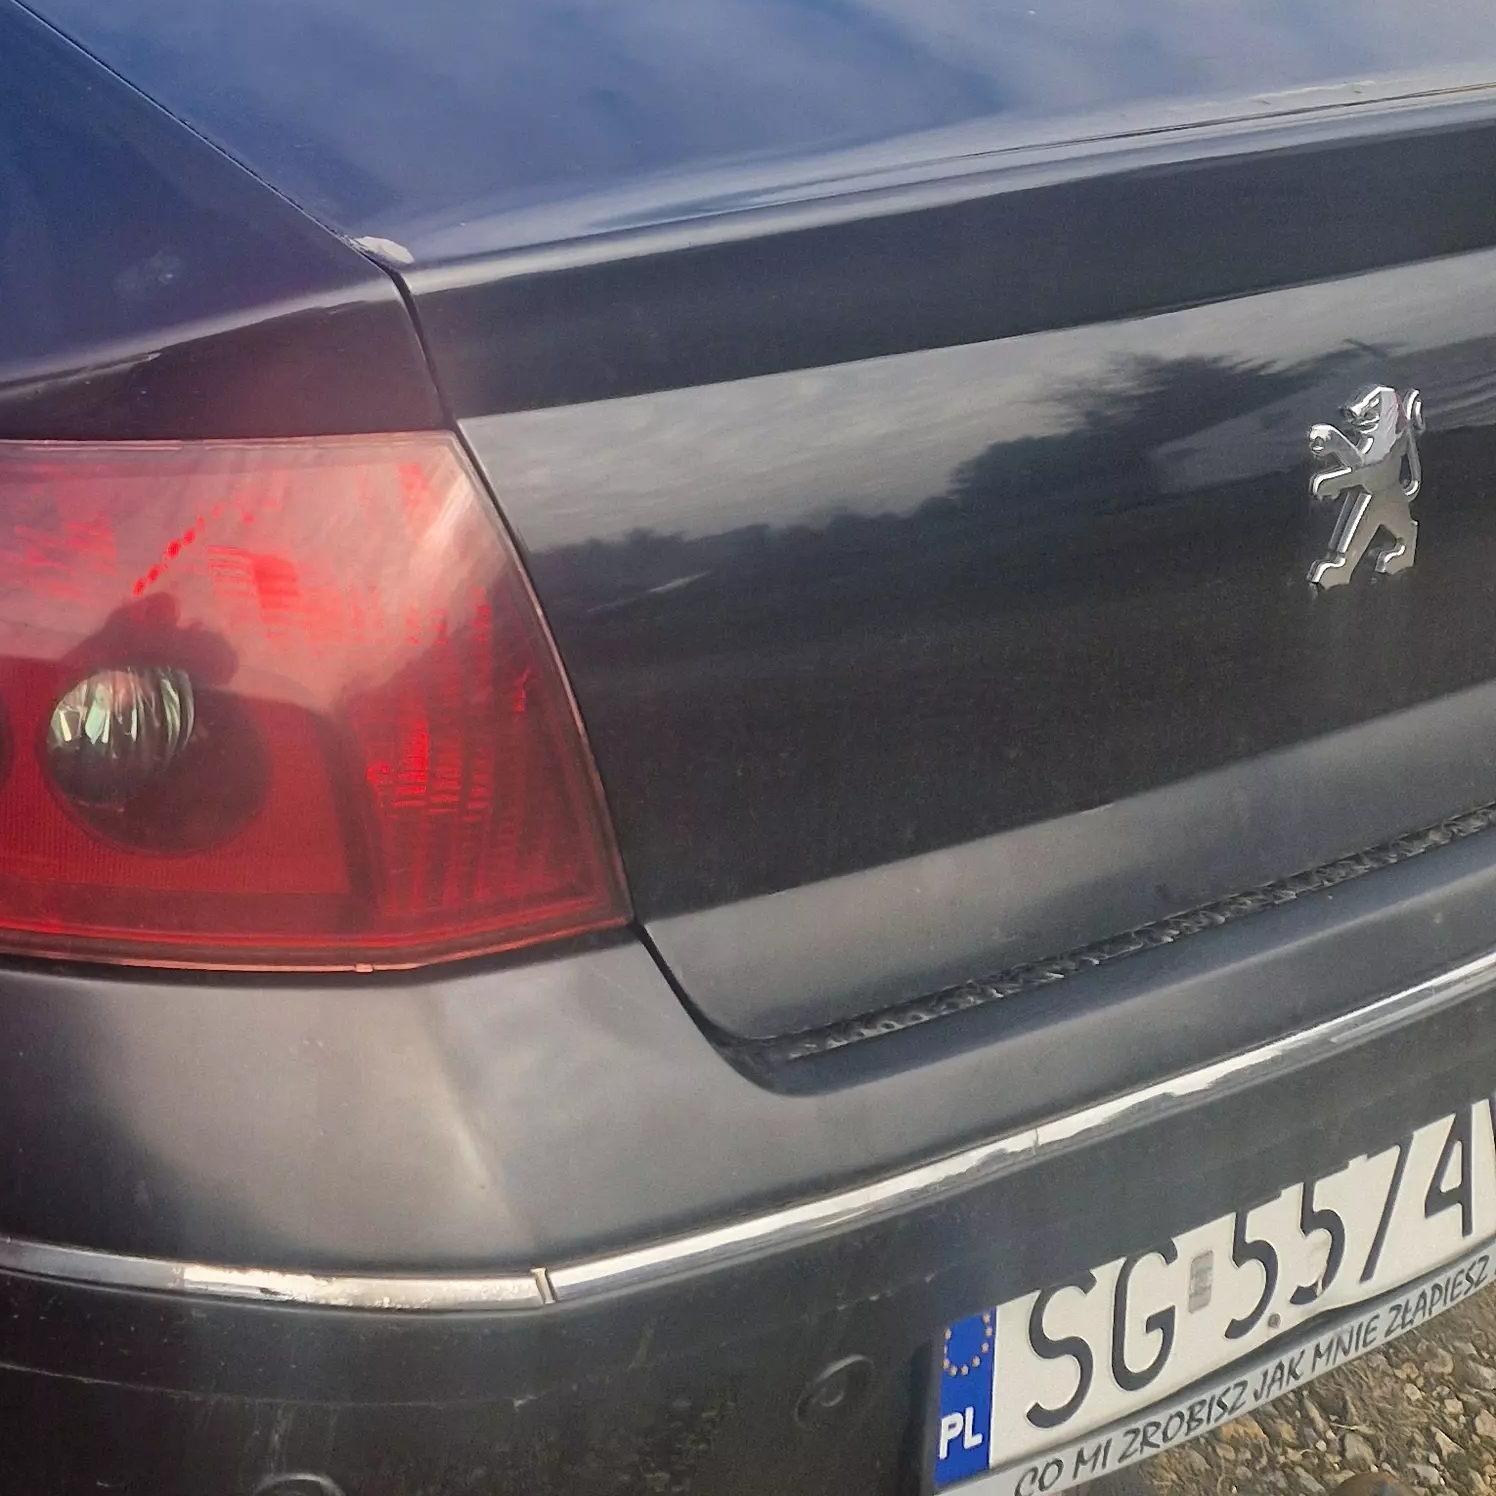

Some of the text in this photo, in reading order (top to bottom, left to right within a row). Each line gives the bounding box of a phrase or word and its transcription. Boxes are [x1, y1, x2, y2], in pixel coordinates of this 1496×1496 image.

[1026, 1101, 1496, 1429] SG 5574
[1073, 1437, 1112, 1481] MI
[1118, 1380, 1249, 1464] ZROBISZ
[1253, 1349, 1306, 1402] JAK
[1311, 1314, 1380, 1372] MNIE
[1385, 1254, 1490, 1338] ZŁAPIESZ
[938, 1406, 984, 1459] PL
